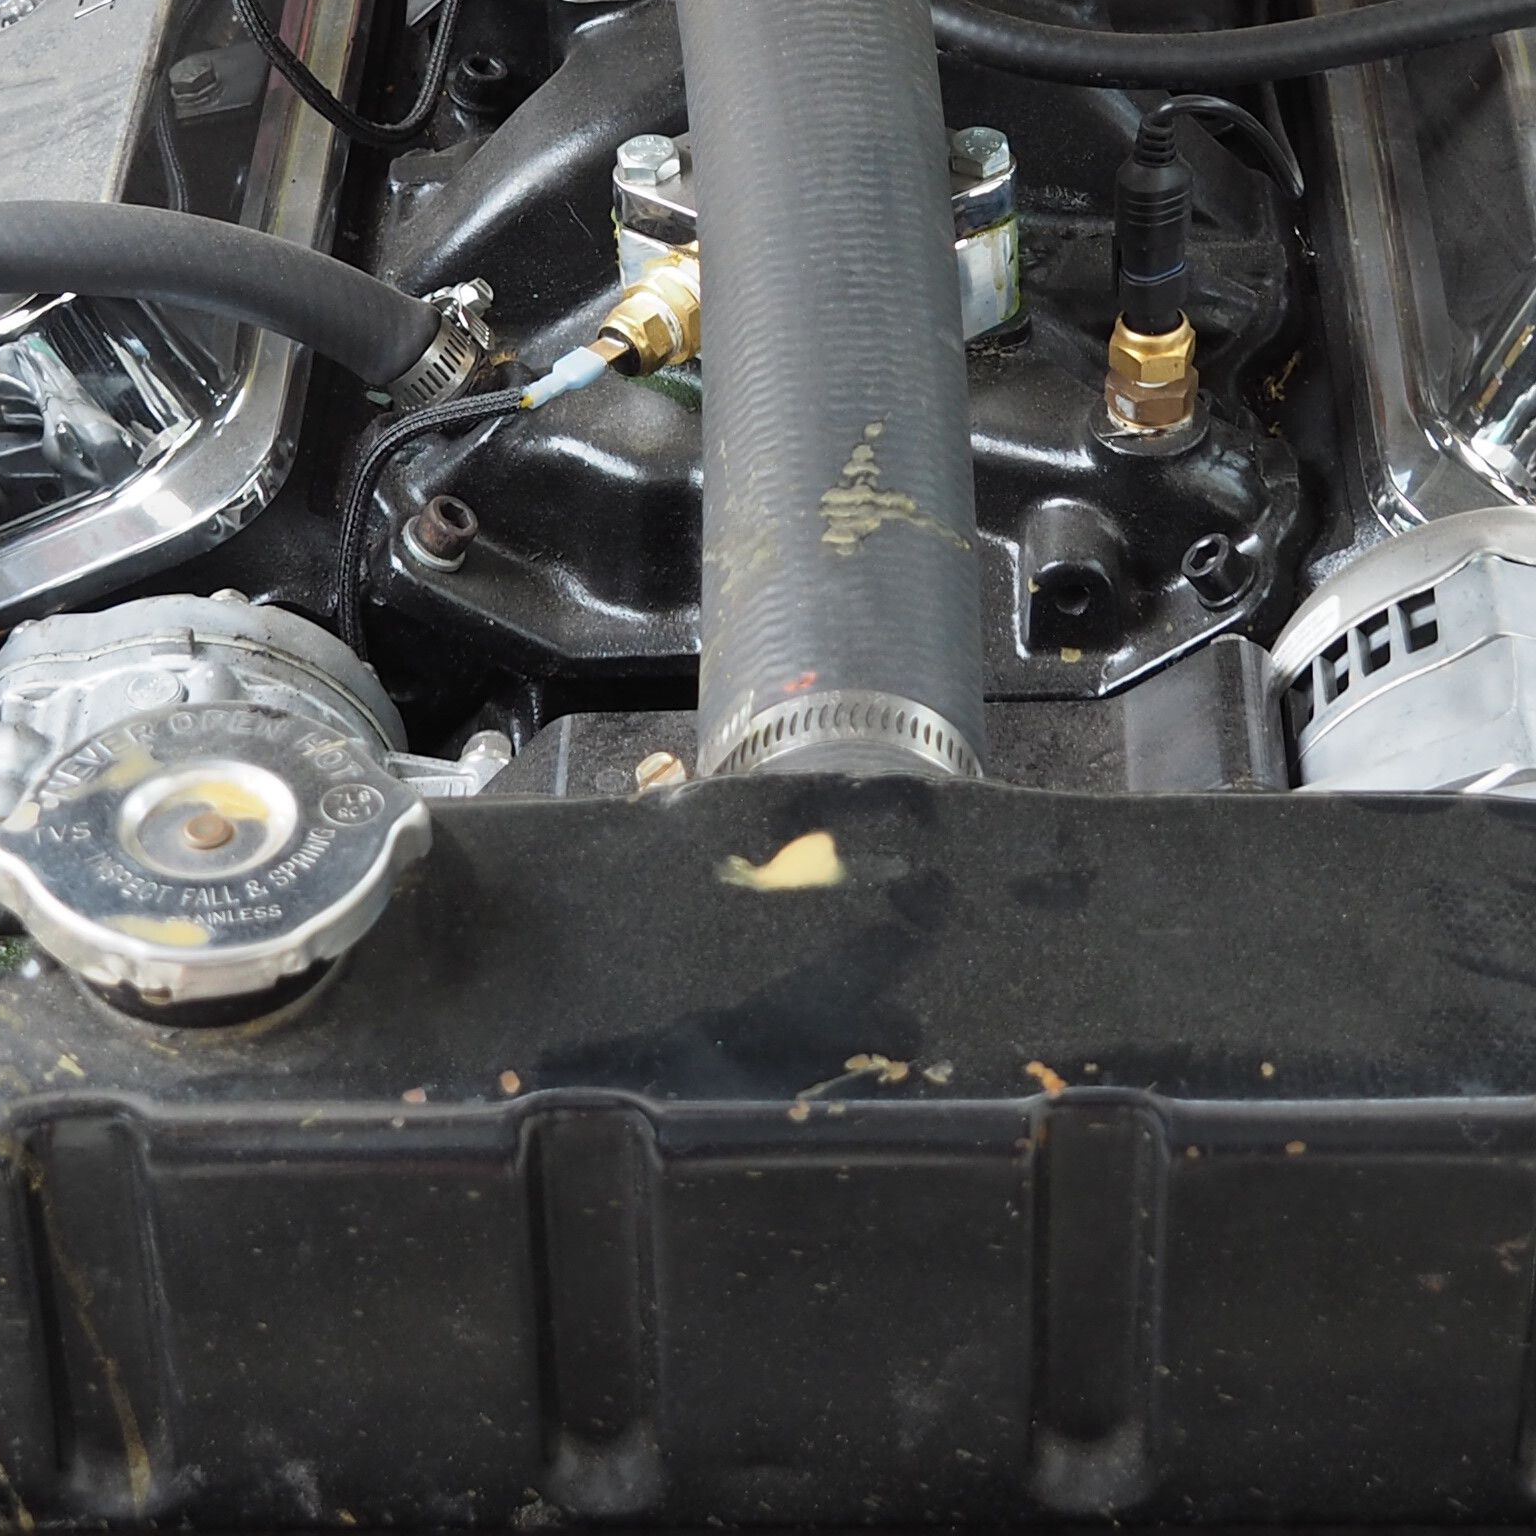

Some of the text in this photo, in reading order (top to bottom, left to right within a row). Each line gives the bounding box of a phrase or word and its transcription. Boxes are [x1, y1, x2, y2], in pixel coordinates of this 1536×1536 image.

[41, 711, 365, 799] NEVER OPEN HOT
[85, 852, 174, 904] INSPECT
[245, 878, 269, 899] &
[268, 827, 336, 887] SPRING
[166, 903, 283, 926] AINLESS
